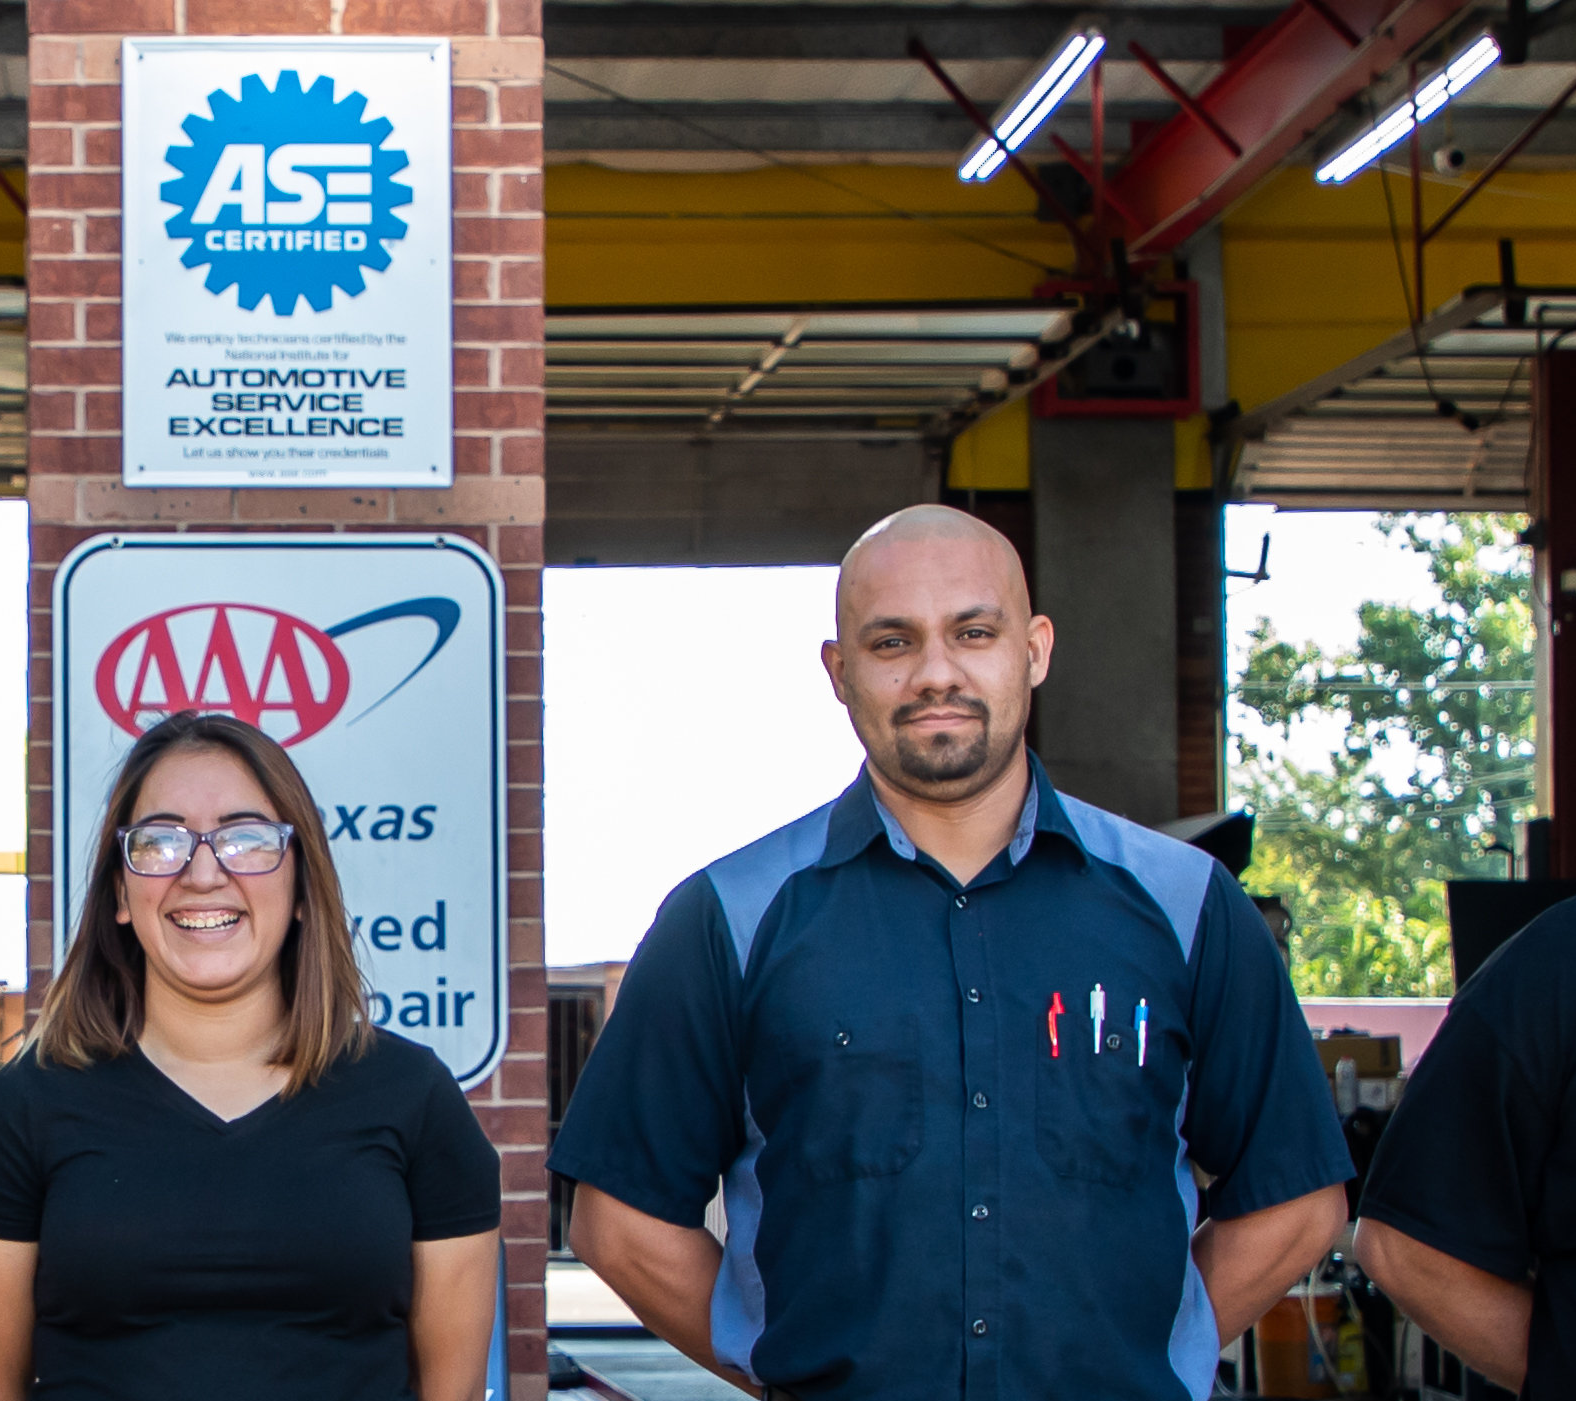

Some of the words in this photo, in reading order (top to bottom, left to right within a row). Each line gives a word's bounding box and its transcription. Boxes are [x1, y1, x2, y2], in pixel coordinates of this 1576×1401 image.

[190, 143, 373, 225] ASE
[204, 229, 368, 252] CERTIFIED
[165, 368, 407, 389] AUTOMOTIVE
[211, 392, 364, 412] SERVICE
[168, 416, 404, 437] EXCELLENCE
[118, 605, 324, 744] AAA
